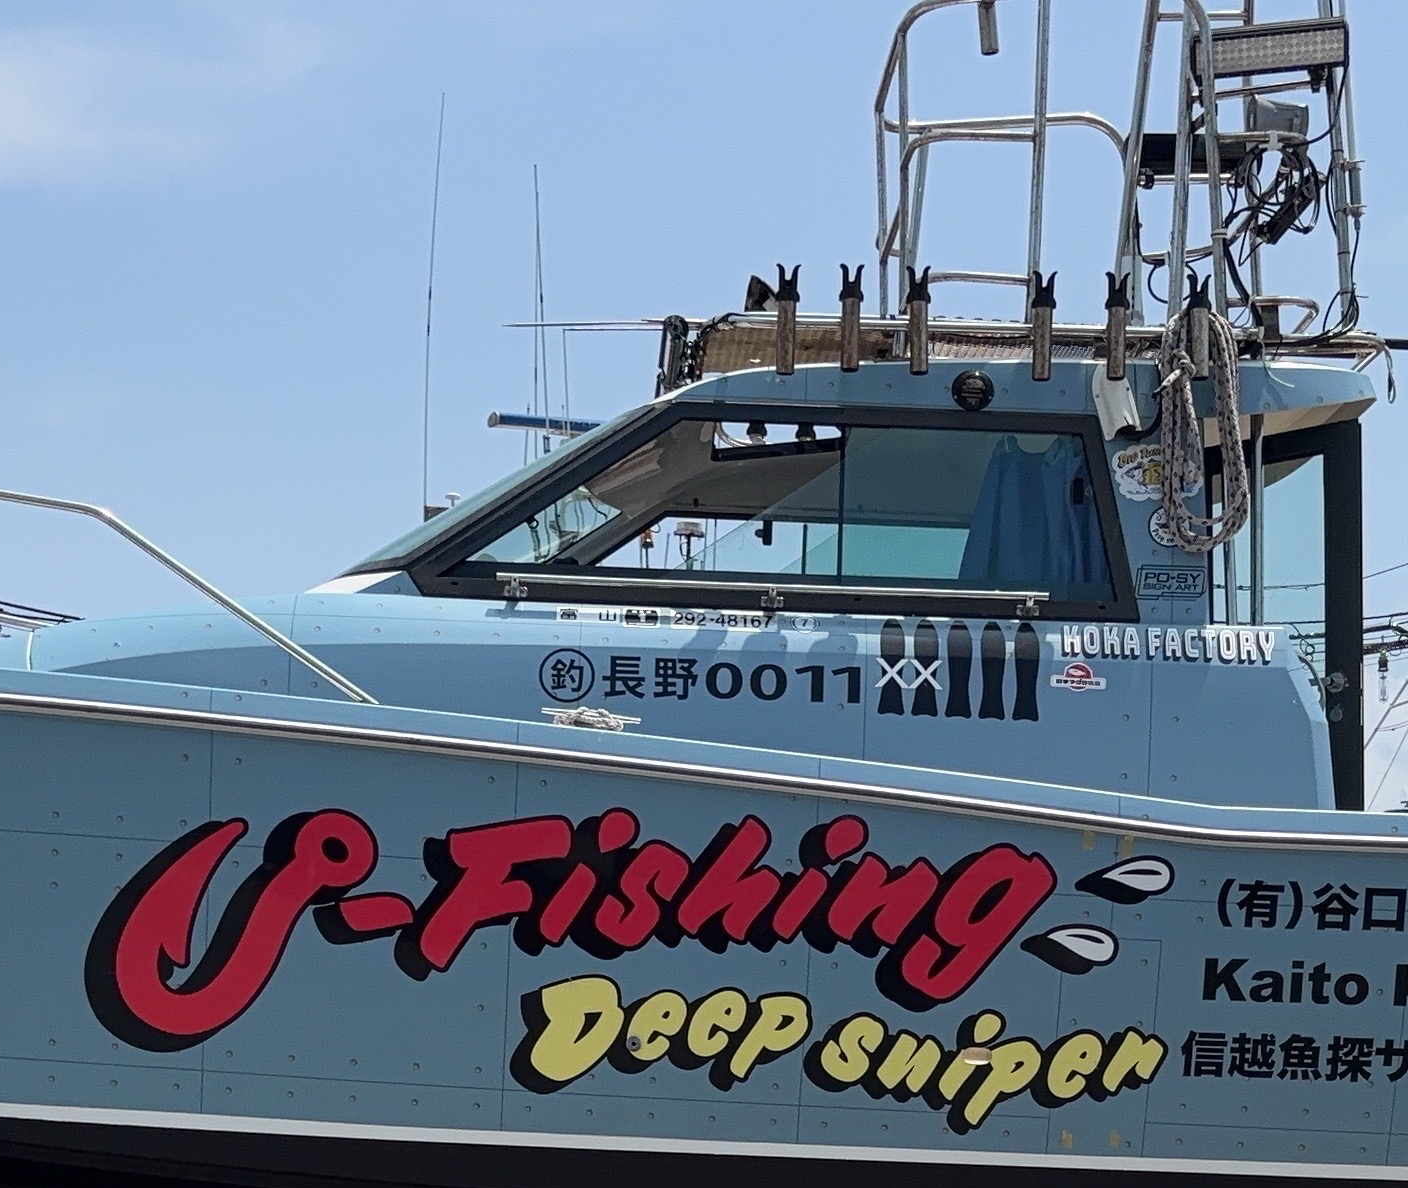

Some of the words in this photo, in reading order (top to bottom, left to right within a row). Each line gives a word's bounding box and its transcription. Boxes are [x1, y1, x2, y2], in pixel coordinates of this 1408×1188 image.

[1142, 582, 1172, 591] SIGN
[1174, 583, 1200, 592] ART
[673, 612, 773, 629] 292-48167
[1145, 627, 1276, 666] FACTORY
[601, 655, 862, 704] 長野0011
[1201, 957, 1370, 1006] Kaito
[511, 973, 813, 1095] Deep
